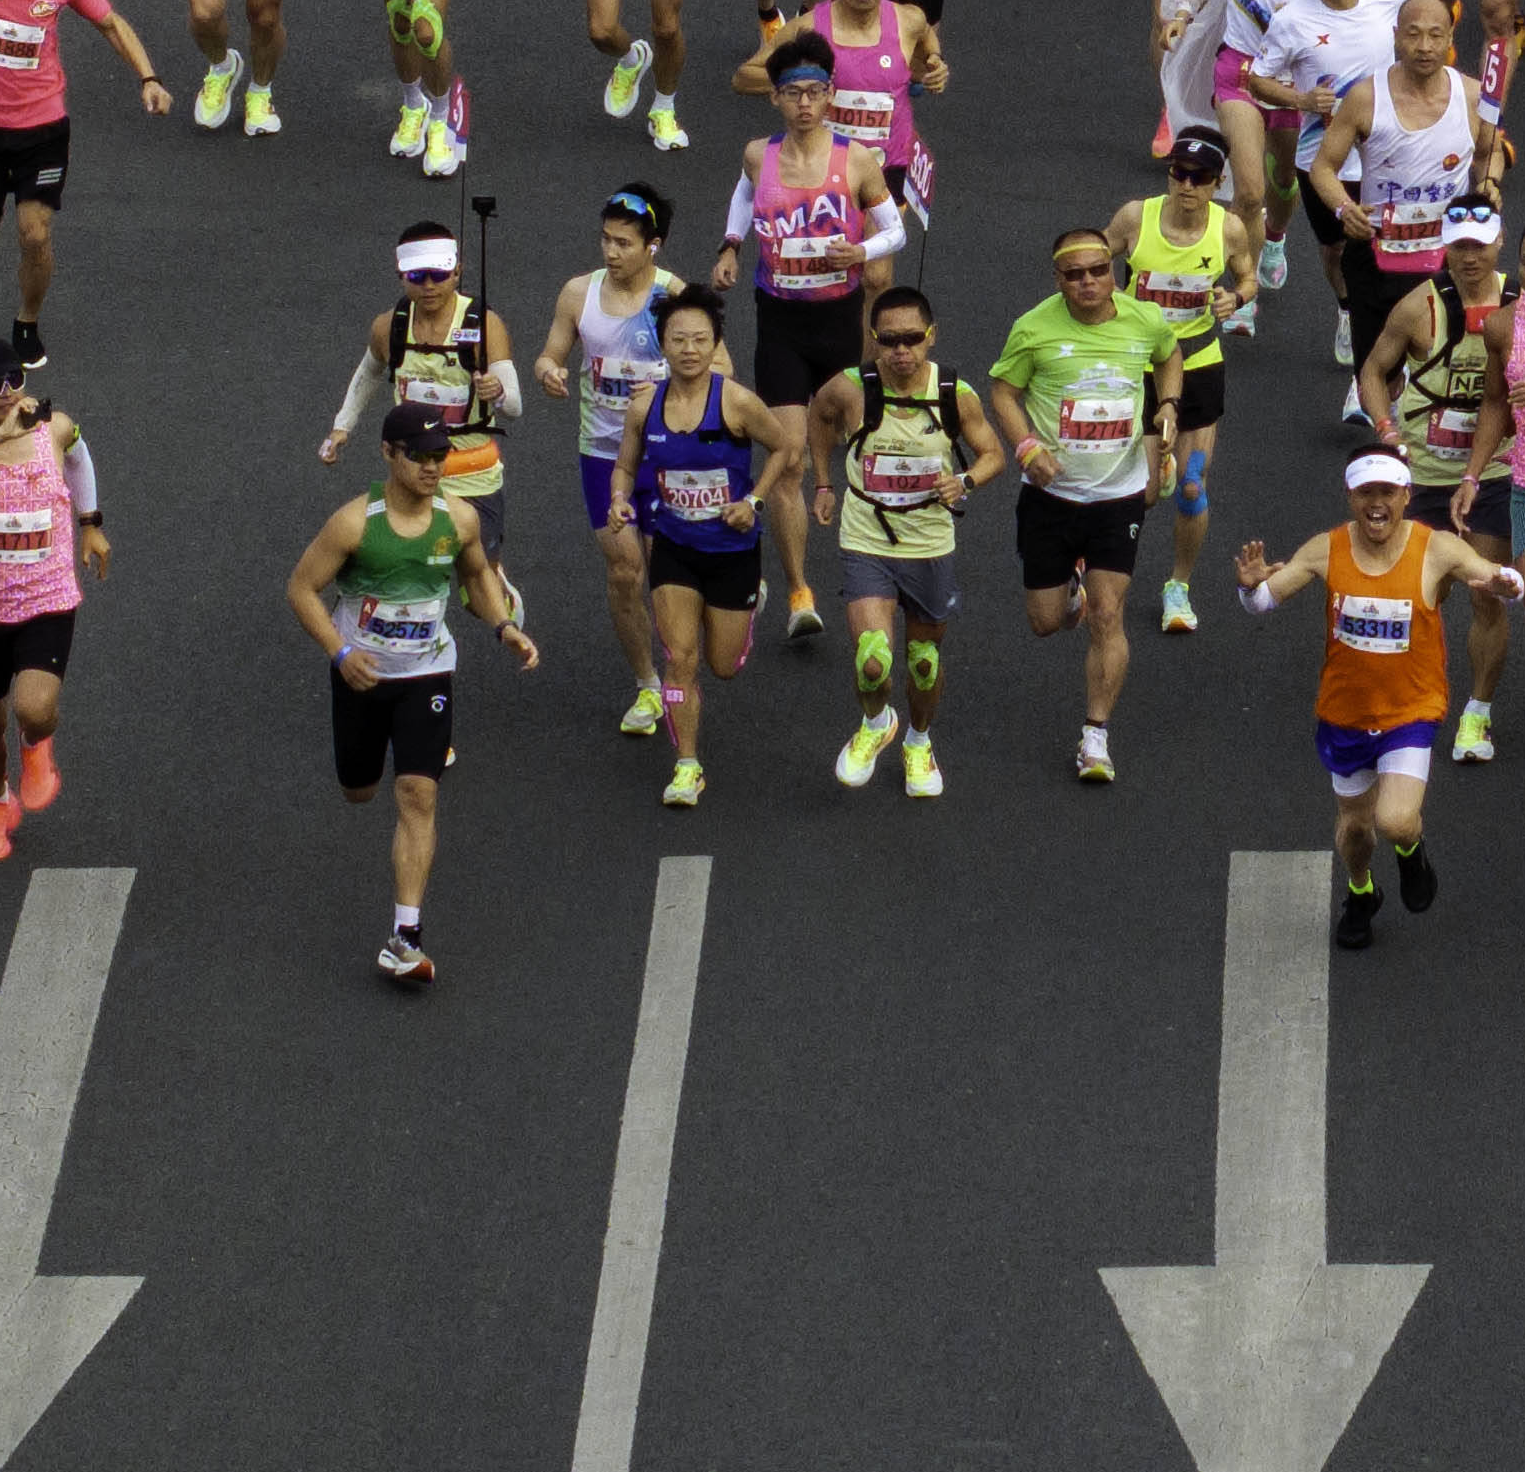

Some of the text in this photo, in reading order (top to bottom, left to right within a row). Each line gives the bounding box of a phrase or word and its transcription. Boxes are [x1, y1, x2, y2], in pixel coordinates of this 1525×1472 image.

[834, 108, 890, 128] 10157
[1075, 421, 1130, 441] 12774
[885, 474, 921, 490] 102
[668, 487, 724, 508] 20704
[372, 619, 434, 640] 52575
[1344, 618, 1404, 640] 53318
